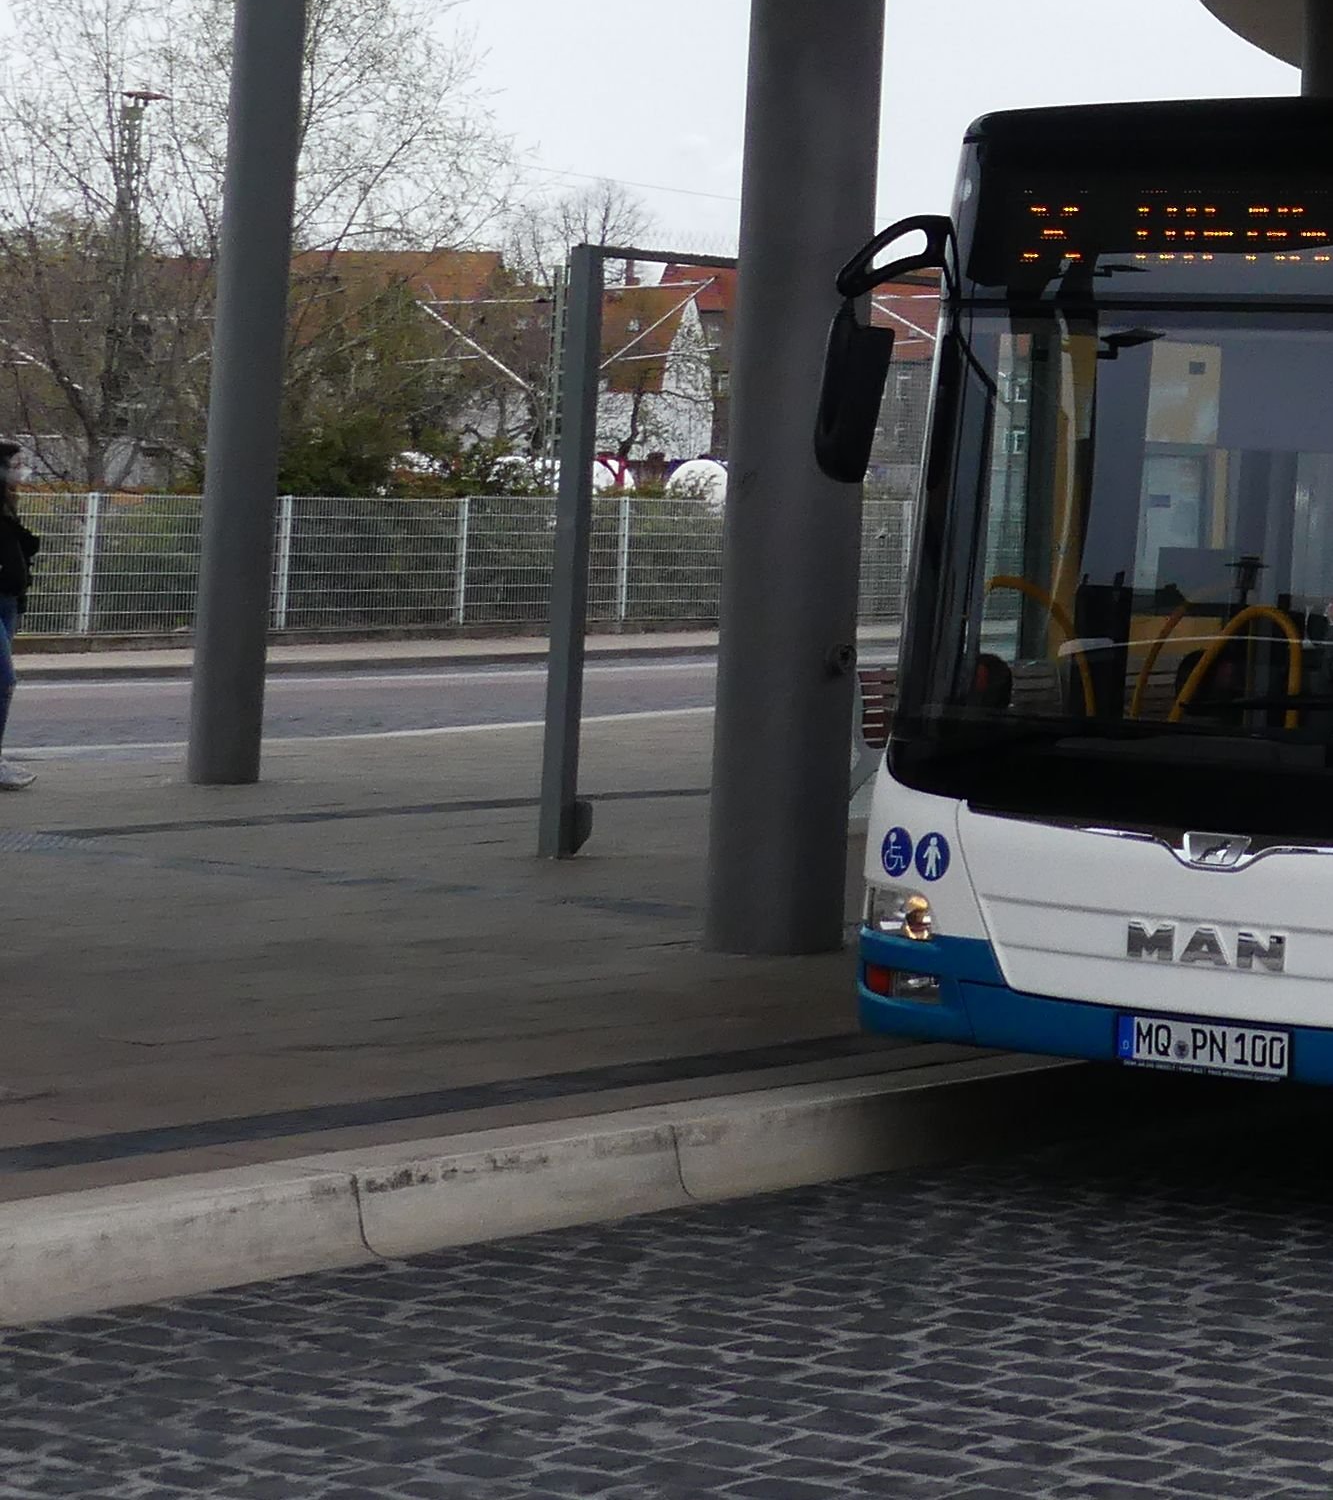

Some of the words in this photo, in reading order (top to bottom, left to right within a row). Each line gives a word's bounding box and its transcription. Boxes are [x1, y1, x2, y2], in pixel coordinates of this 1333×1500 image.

[1126, 919, 1287, 973] MAN
[1136, 1021, 1172, 1057] MQ
[1190, 1027, 1227, 1064] PN
[1233, 1032, 1286, 1070] 100
